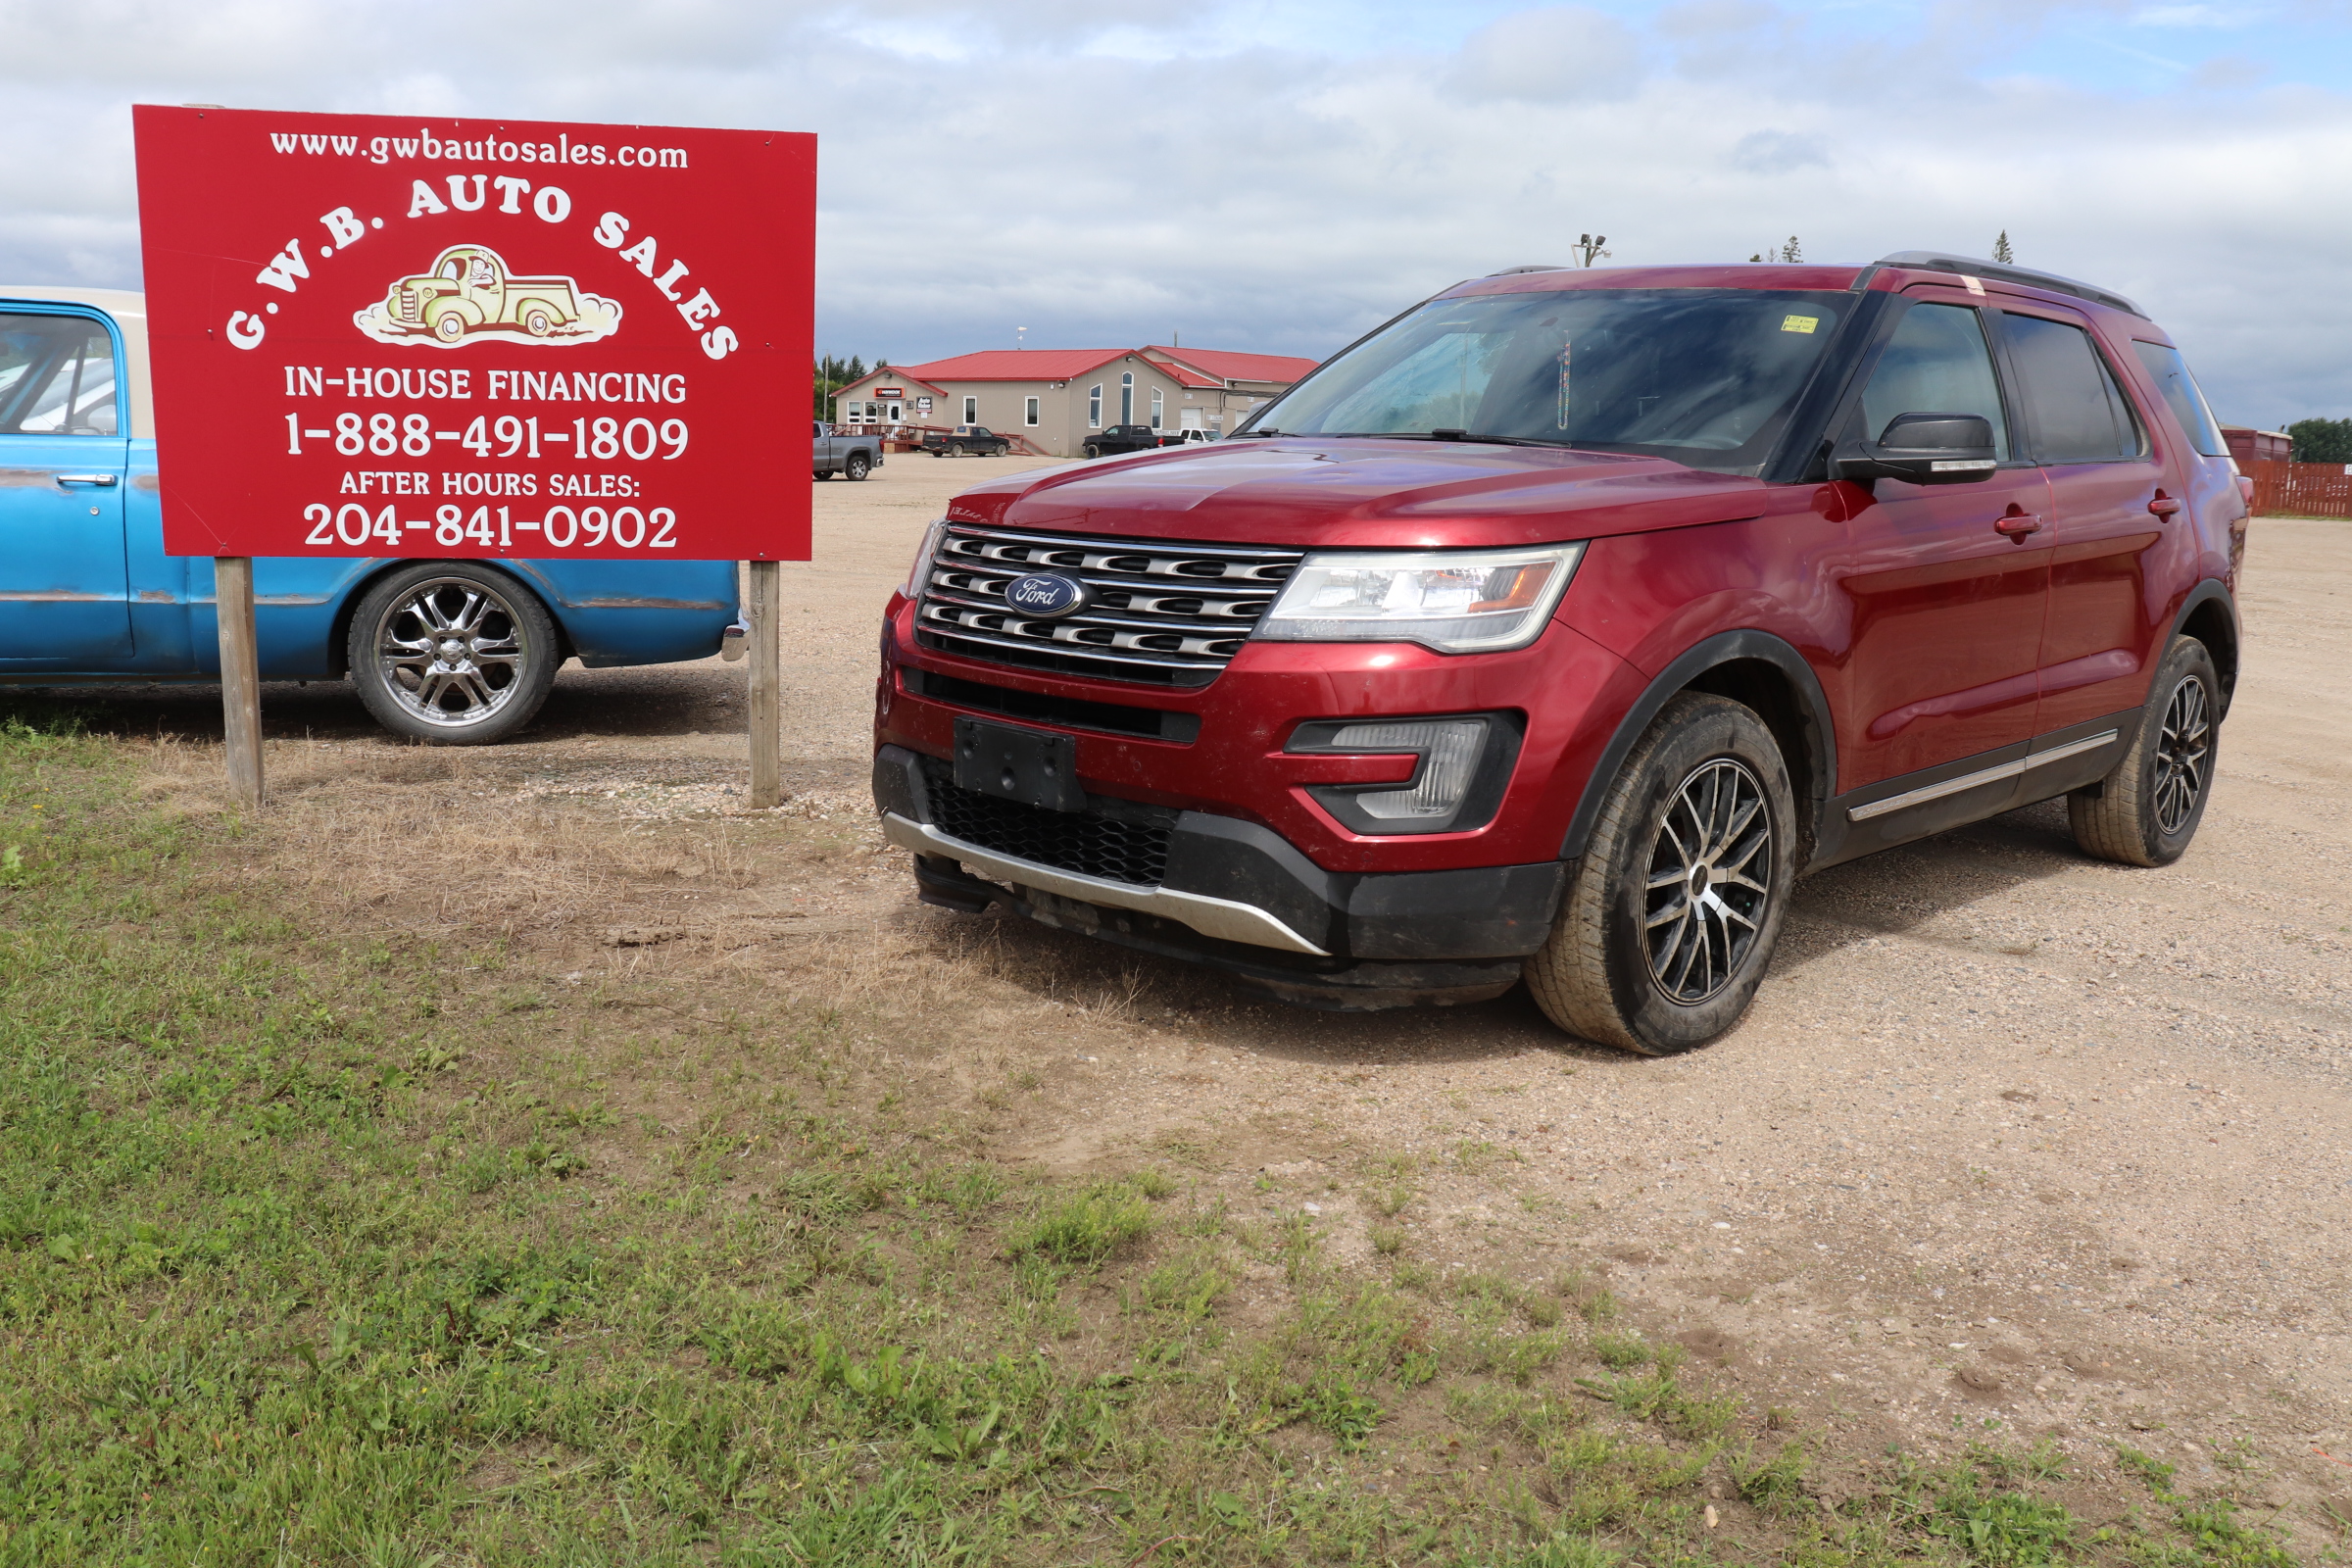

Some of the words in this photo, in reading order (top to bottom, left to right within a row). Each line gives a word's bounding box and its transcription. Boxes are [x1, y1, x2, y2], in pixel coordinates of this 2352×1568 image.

[270, 127, 688, 168] www.gwbautosales.com
[225, 206, 383, 351] G.W.B.
[406, 173, 571, 223] AUTO
[593, 211, 739, 361] SALES
[283, 366, 472, 400] IN-HOUSE
[487, 369, 686, 404] FINANCING
[284, 412, 689, 461] 1-888-491-1809
[339, 470, 430, 495] AFTER
[441, 471, 538, 496] HOURS
[549, 473, 640, 498] SALES:
[303, 503, 677, 549] 204-841-0902
[1015, 578, 1059, 605] Ford
